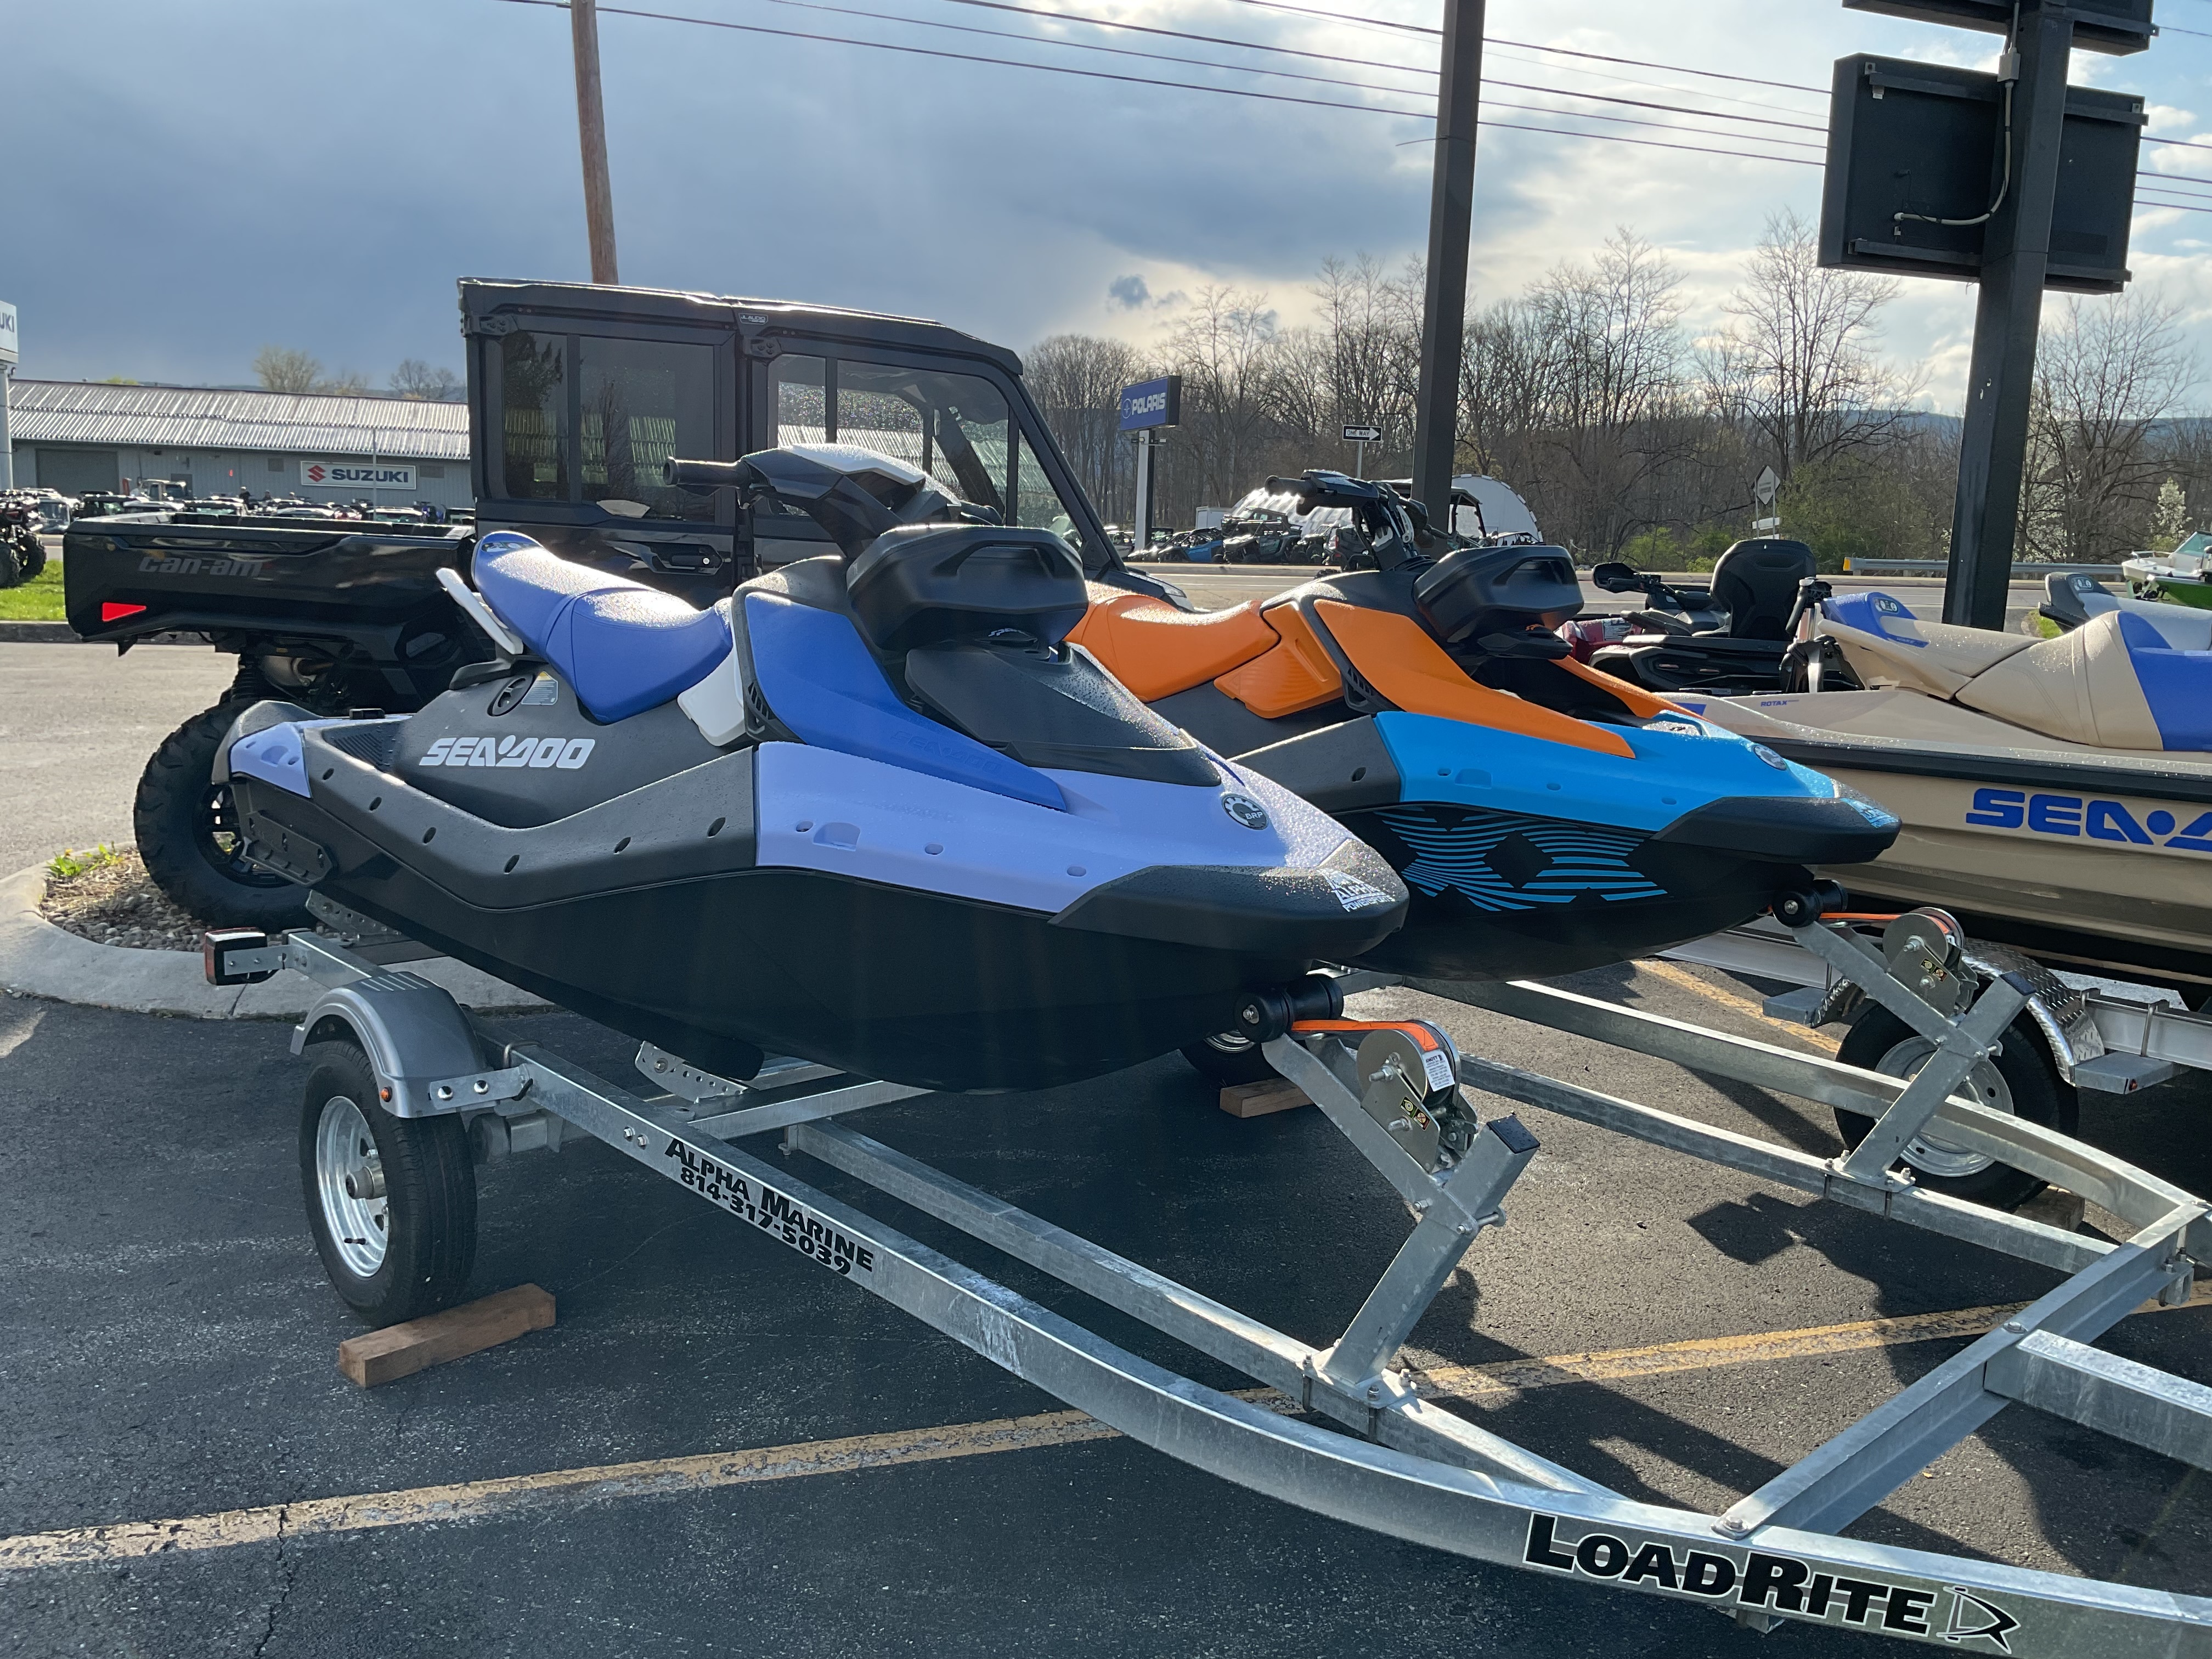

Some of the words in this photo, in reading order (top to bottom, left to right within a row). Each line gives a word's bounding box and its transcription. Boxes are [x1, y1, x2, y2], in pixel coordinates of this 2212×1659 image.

[1132, 393, 1166, 415] POLARIS
[332, 469, 409, 483] SUZUKI
[664, 1137, 751, 1201] ALPHA
[761, 1186, 874, 1273] MARINE
[680, 1166, 851, 1276] 814-317-5039
